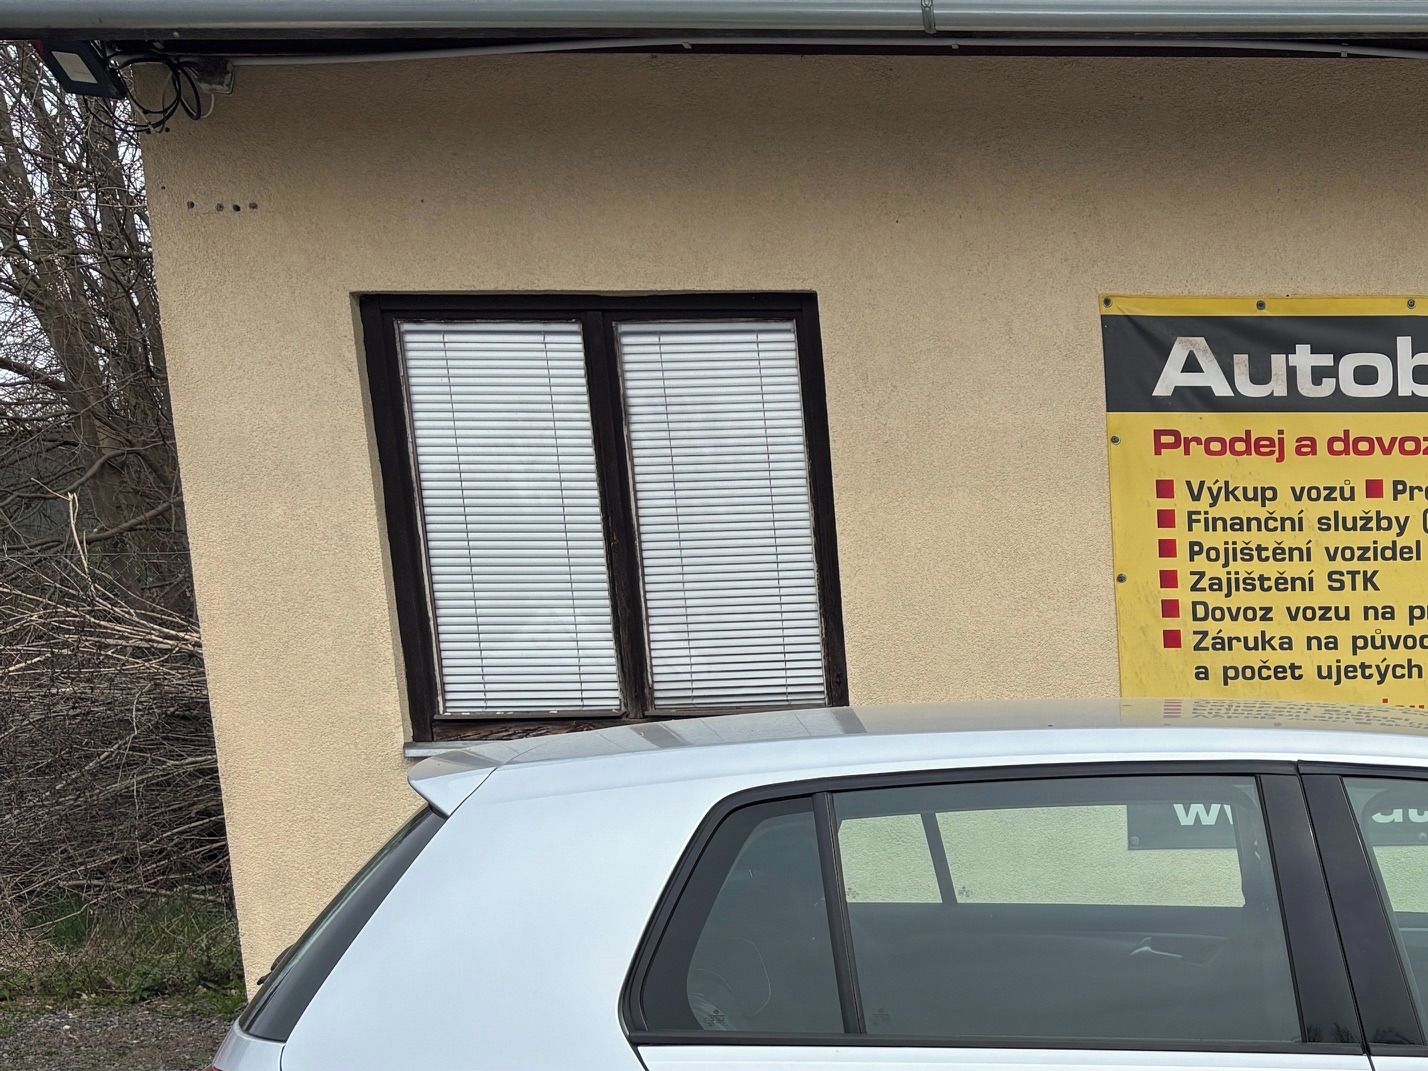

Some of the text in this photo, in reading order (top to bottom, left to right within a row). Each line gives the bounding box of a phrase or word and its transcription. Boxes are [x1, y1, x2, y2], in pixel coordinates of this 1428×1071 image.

[1153, 429, 1285, 463] Prodej
[1296, 434, 1317, 457] a
[1186, 479, 1277, 507] Výkup
[1291, 480, 1356, 501] vozů
[1187, 510, 1304, 532] Finanční
[1318, 510, 1409, 537] služby
[1189, 540, 1421, 568] Pojištění vozidel
[1190, 570, 1380, 598] Zajištění STK
[1192, 601, 1273, 622] Dovoz
[1286, 604, 1350, 621] vozu
[1363, 604, 1395, 620] na
[1193, 629, 1293, 652] Záruka
[1306, 634, 1338, 651] na
[1195, 666, 1209, 681] a
[1223, 660, 1303, 686] počet
[1317, 658, 1422, 685] ujetých
